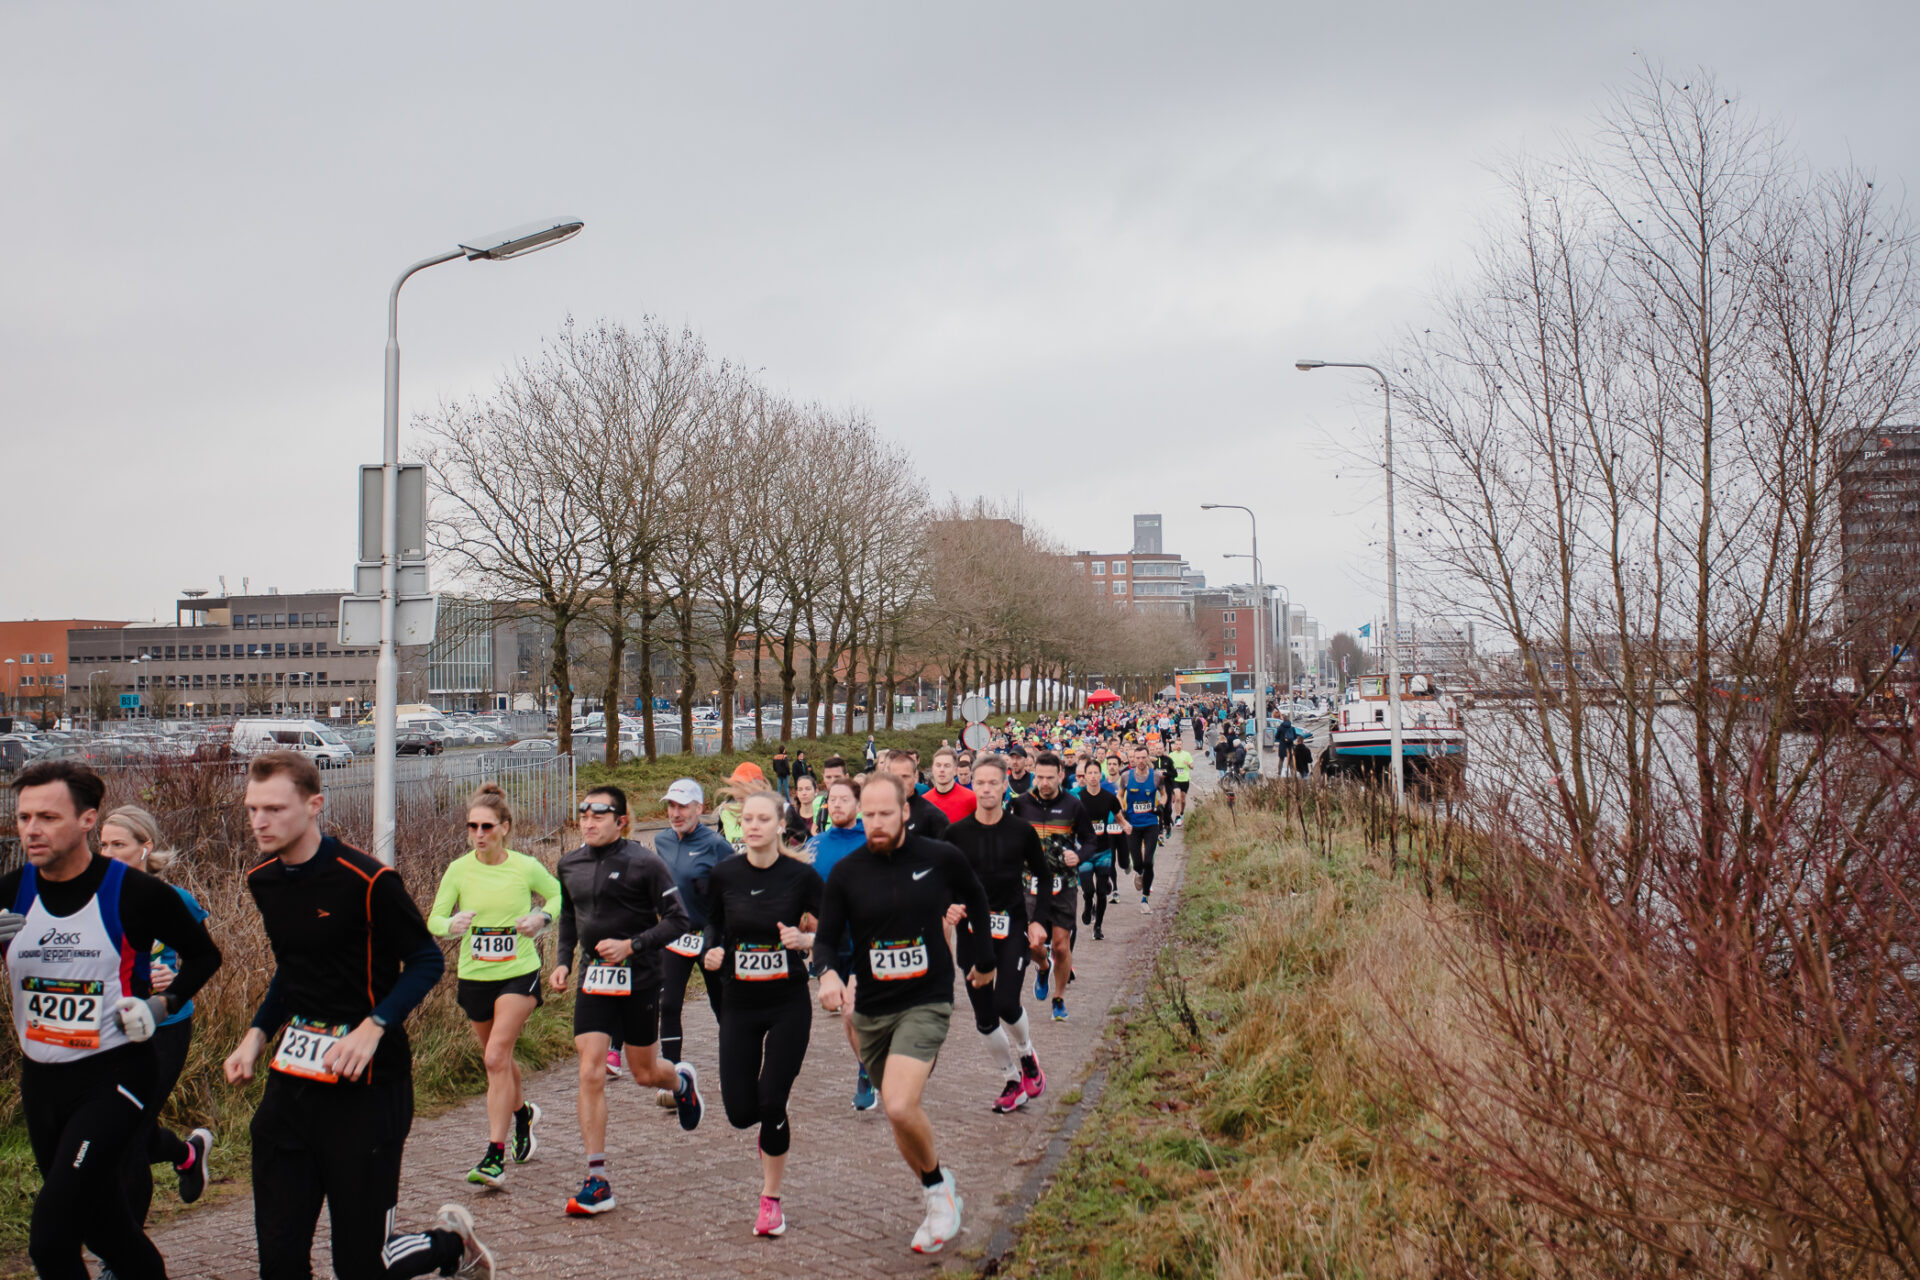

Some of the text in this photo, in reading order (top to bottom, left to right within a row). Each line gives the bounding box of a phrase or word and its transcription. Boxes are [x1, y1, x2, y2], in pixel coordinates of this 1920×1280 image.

[473, 937, 514, 952] 4180
[18, 950, 41, 959] LIQUID
[74, 950, 102, 958] ENERGY
[738, 953, 783, 970] 2203
[874, 949, 923, 968] 2195
[589, 969, 627, 985] 4176
[29, 994, 96, 1022] 4202
